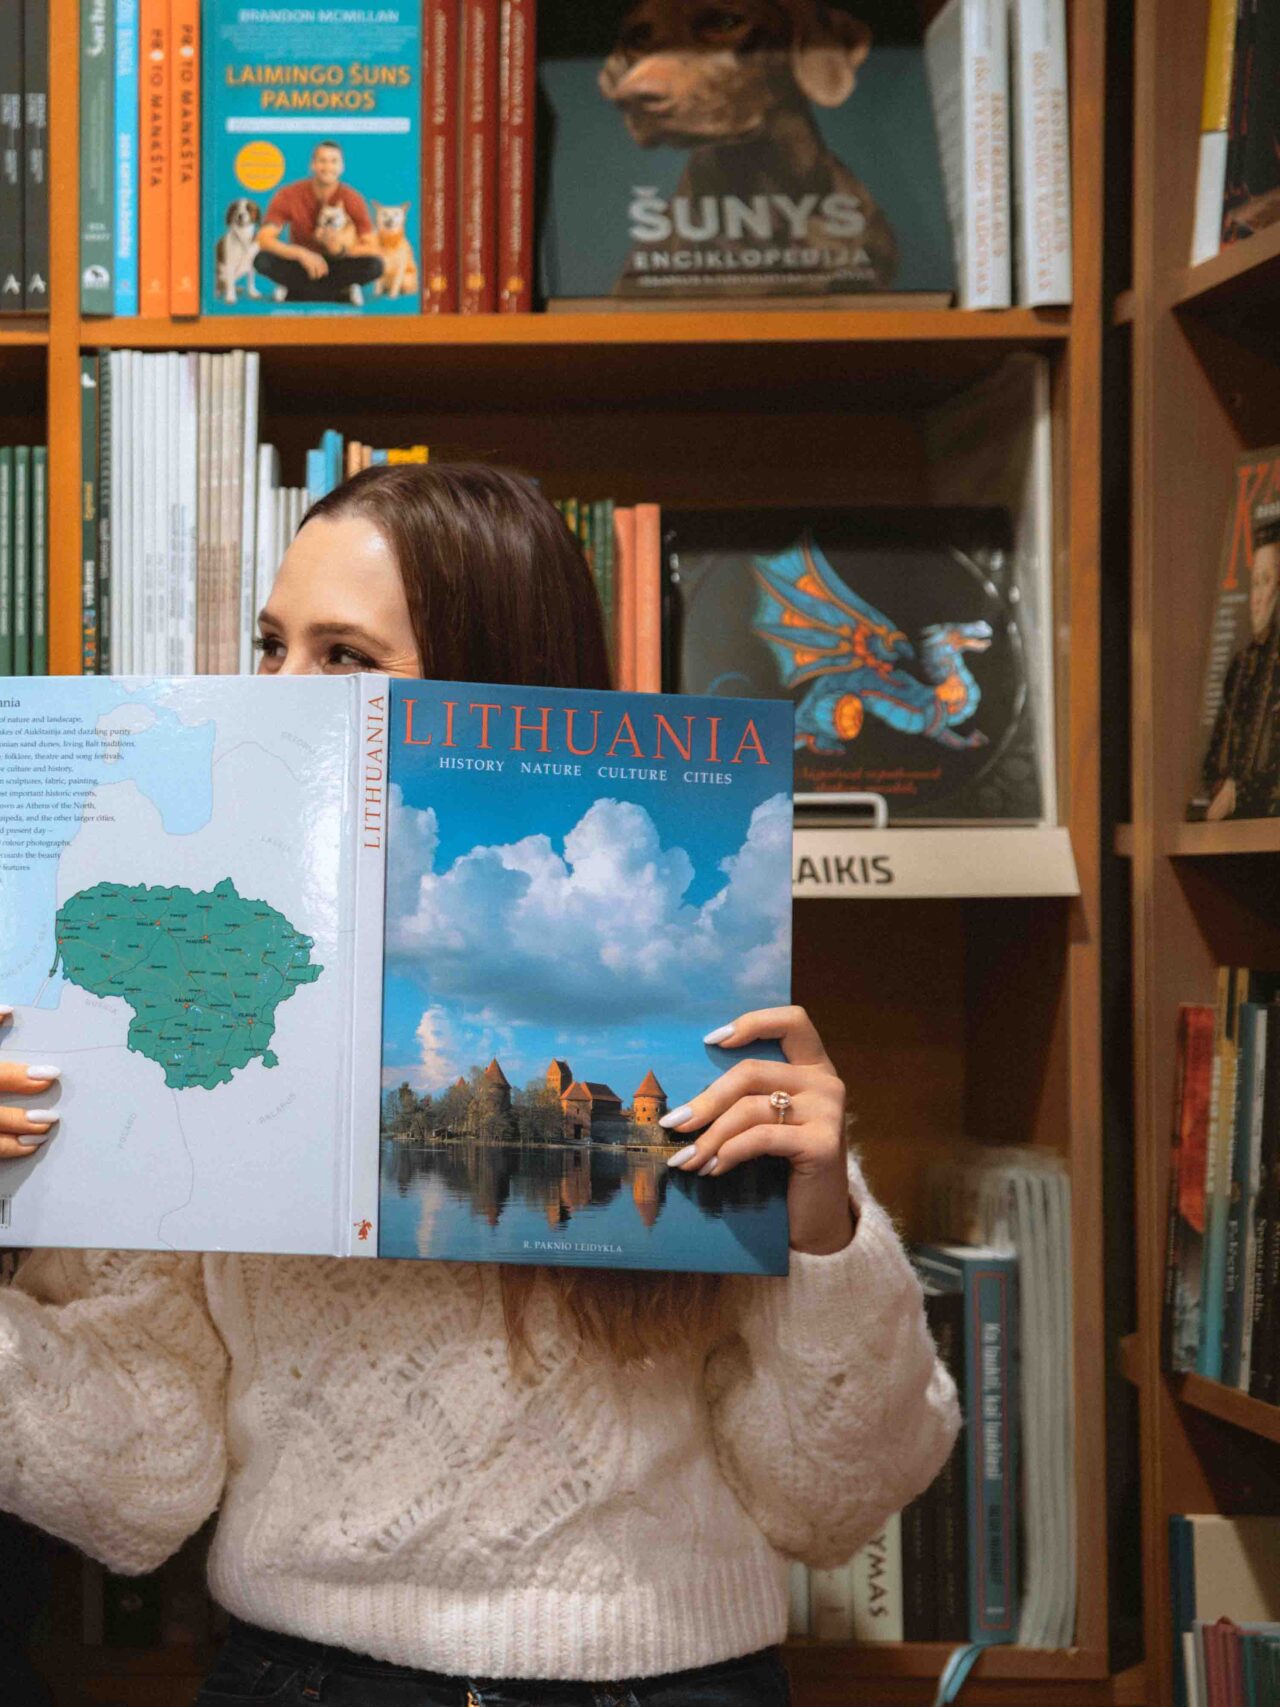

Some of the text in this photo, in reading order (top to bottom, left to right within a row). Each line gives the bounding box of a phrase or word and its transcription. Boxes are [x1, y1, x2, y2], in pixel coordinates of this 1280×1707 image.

[238, 9, 400, 23] BRANDON MCMILLAN
[225, 62, 411, 86] LAIMINGO ŠUNS
[260, 90, 376, 110] PAMOKOS
[150, 94, 166, 188] MANKŠTA
[180, 90, 196, 184] MANKŠTA
[627, 186, 867, 243] ŠUNYS
[632, 250, 870, 271] ENCIKLOPEDIJA
[401, 698, 770, 765] LITHUANIA
[363, 694, 385, 849] LITHUANIA
[439, 757, 733, 785] HISTORY NATURE CULTURE CITIES
[793, 855, 895, 885] AIKIS
[523, 1240, 623, 1253] R. PAKNIO LEIDYKLA
